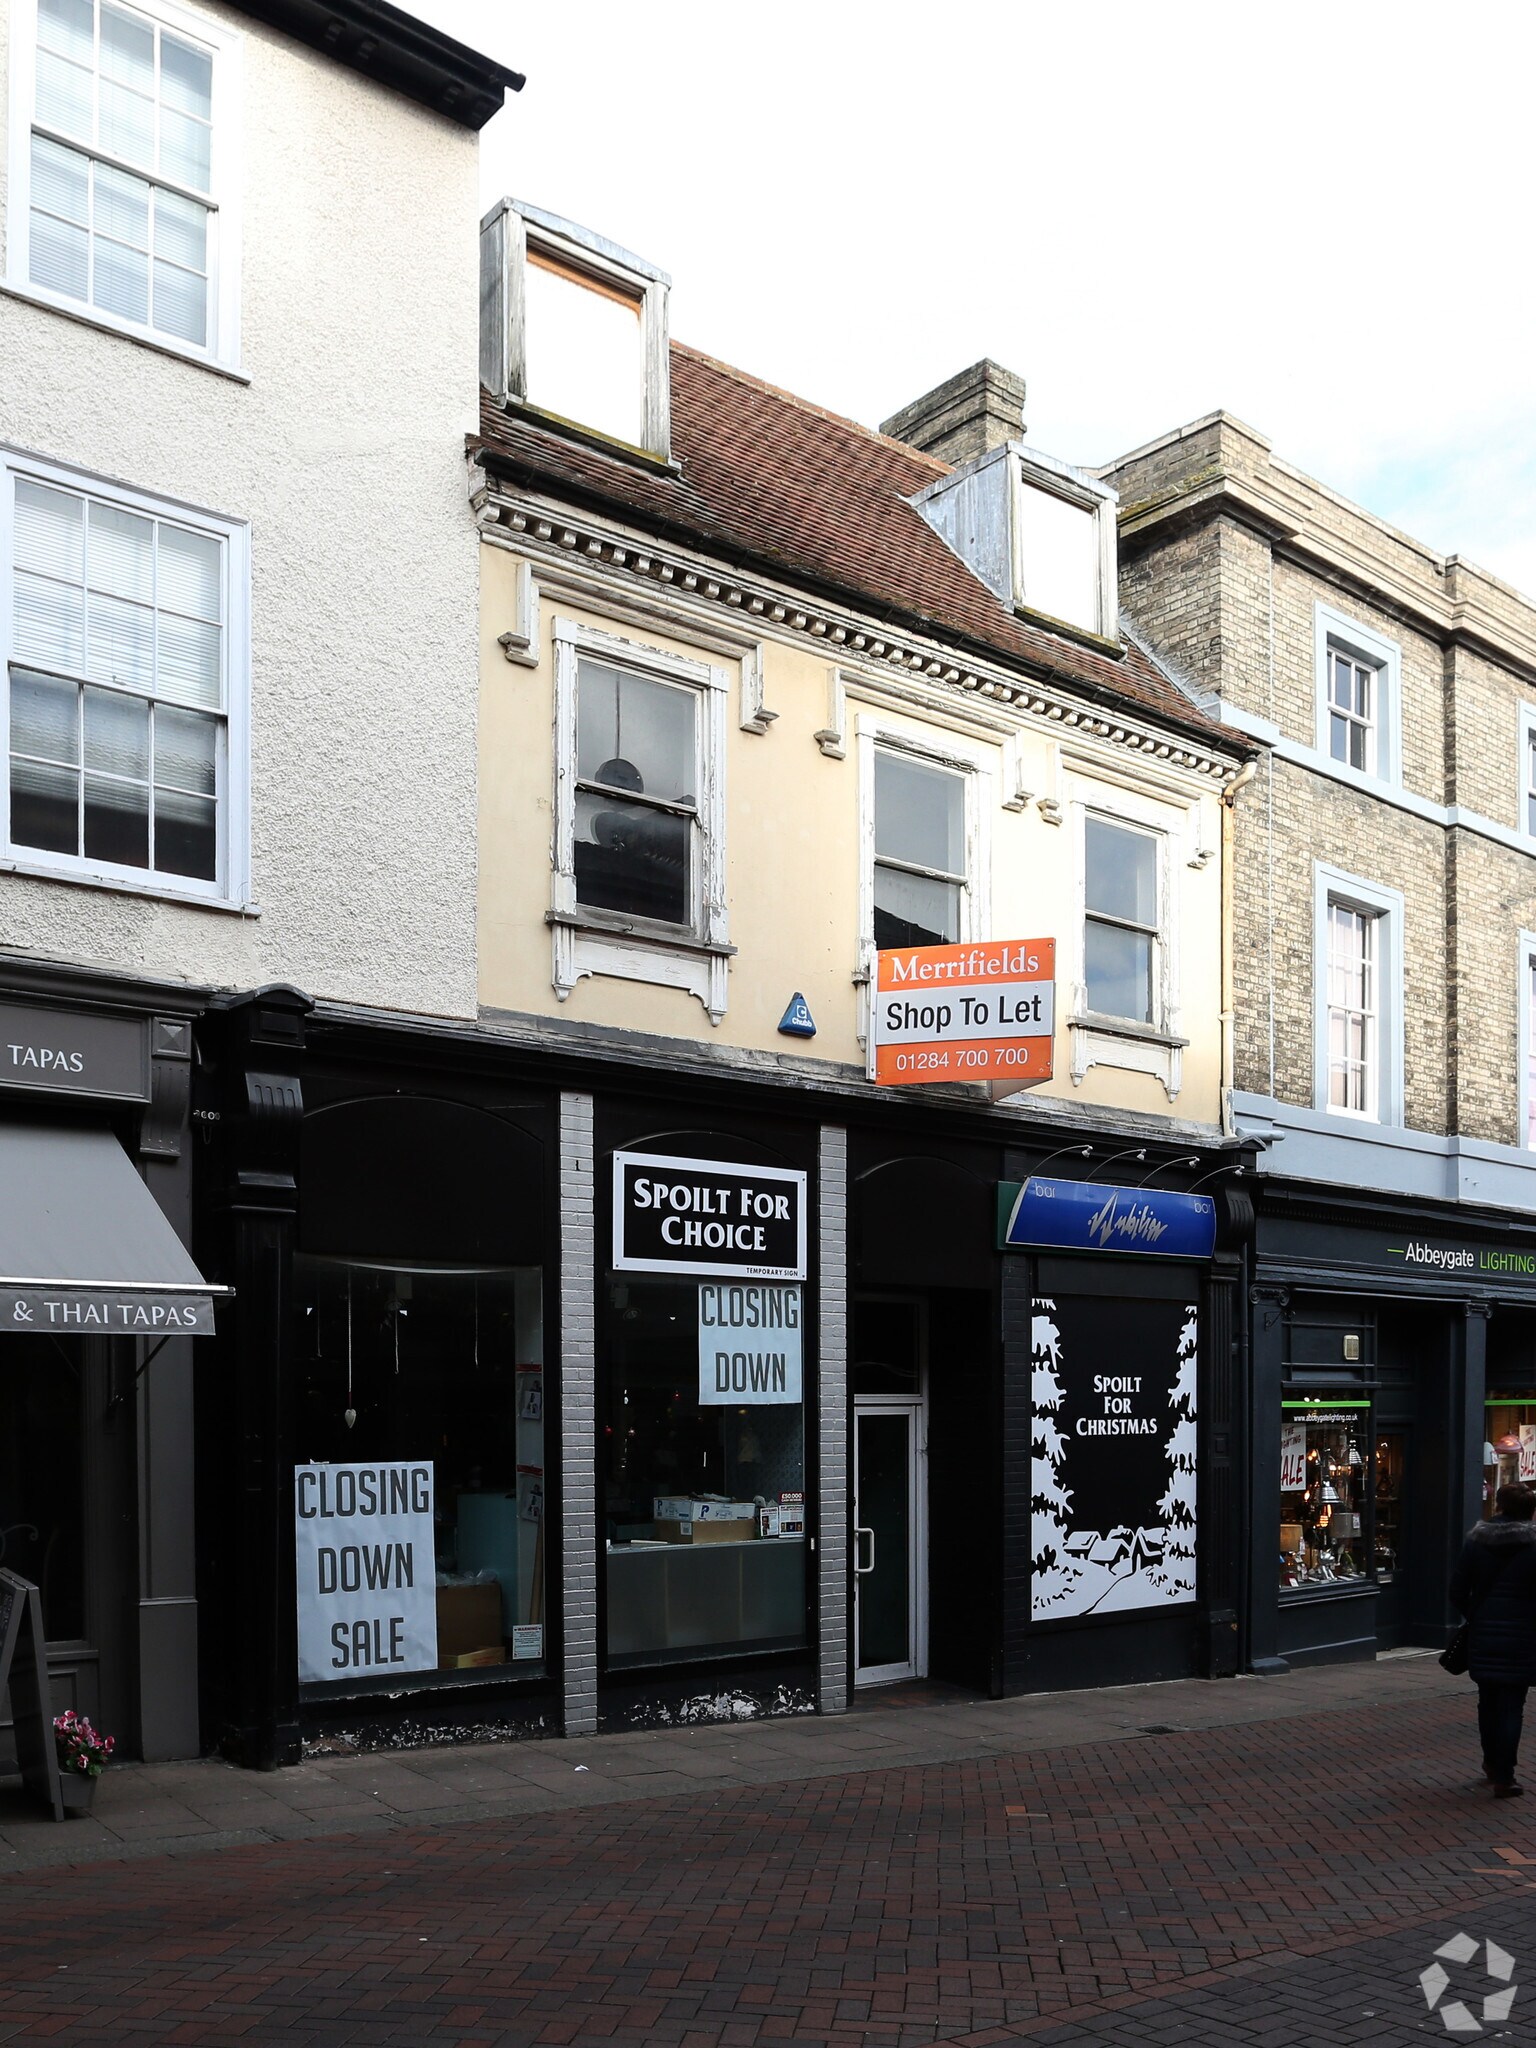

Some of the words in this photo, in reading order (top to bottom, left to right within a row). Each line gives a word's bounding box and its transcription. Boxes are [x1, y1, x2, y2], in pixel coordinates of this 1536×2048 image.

[890, 945, 1040, 983] Merrifields
[792, 1017, 812, 1027] Chubb
[886, 1002, 952, 1034] Shop
[959, 997, 989, 1026] To
[998, 994, 1042, 1024] Let
[7, 1044, 84, 1073] TAPAS
[896, 1052, 949, 1071] 01284
[955, 1049, 988, 1067] 700
[994, 1047, 1028, 1065] 700
[740, 1188, 791, 1220] FOR
[1035, 1182, 1056, 1199] bar
[746, 1267, 783, 1276] TEMPORARY
[784, 1269, 798, 1277] SIGN
[1404, 1242, 1475, 1270] Abbeygate
[1479, 1251, 1536, 1274] LIGHTING
[13, 1300, 34, 1322] &
[44, 1302, 109, 1324] THAI
[116, 1304, 198, 1326] TAPAS
[701, 1285, 798, 1329] CLOSING
[715, 1352, 786, 1393] DOWN
[1104, 1396, 1132, 1414] FOR
[1293, 1412, 1358, 1423] www.abbeygatelighting.co.uk
[298, 1468, 430, 1519] CLOSING
[317, 1542, 414, 1595] DOWN
[331, 1616, 405, 1669] SALE
